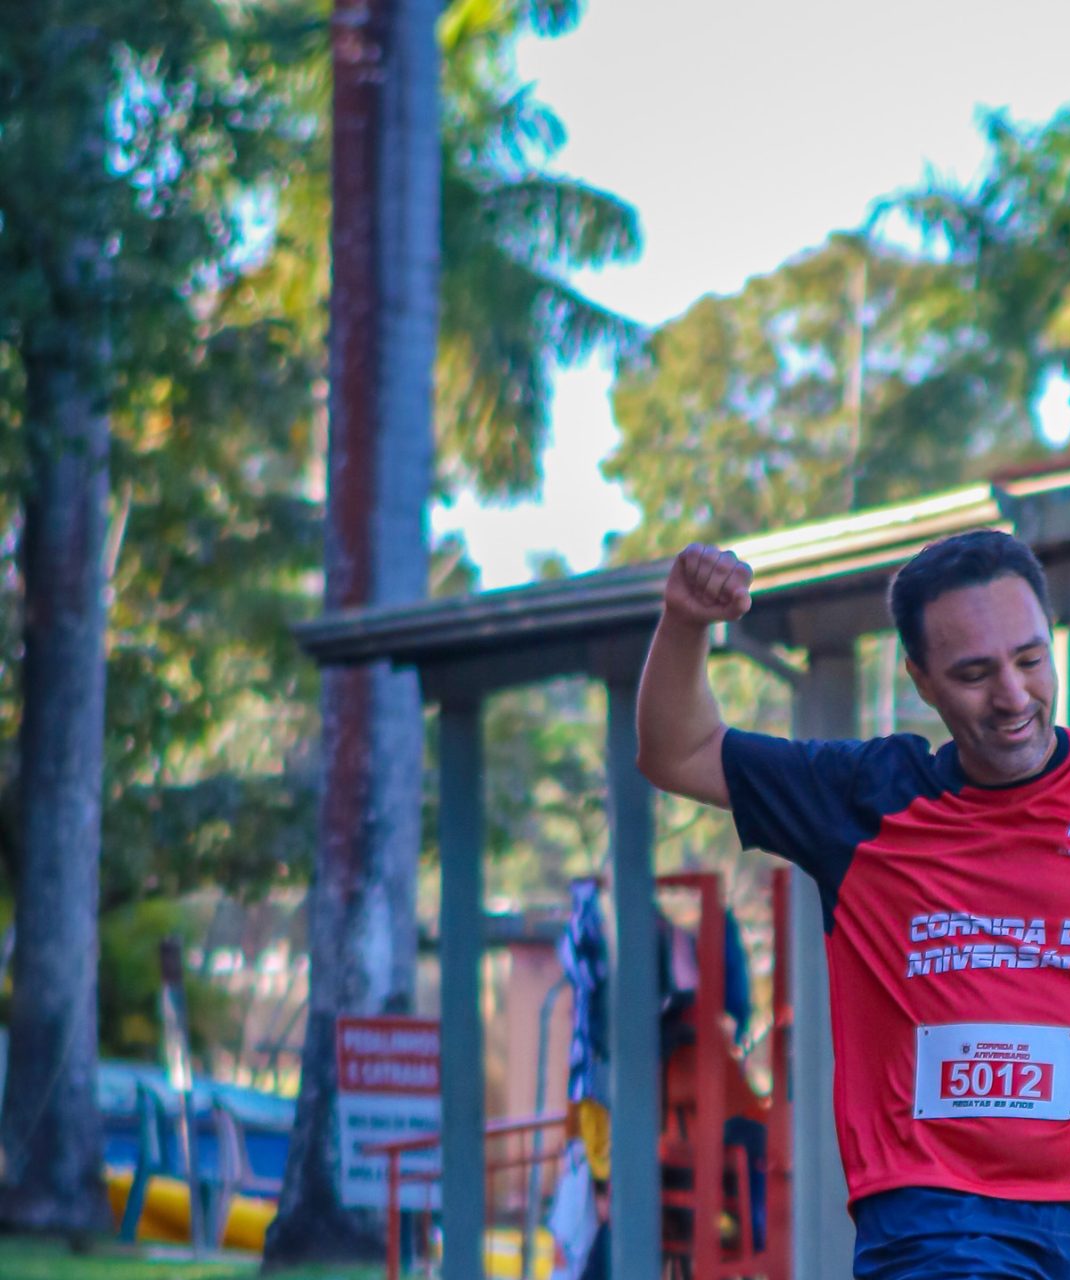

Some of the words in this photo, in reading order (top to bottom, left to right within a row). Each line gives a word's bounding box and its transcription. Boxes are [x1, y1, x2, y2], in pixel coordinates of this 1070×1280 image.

[911, 912, 1046, 944] CORRIDA
[949, 1063, 1042, 1098] 5012
[952, 1100, 991, 1108] REGATAS
[1009, 1101, 1034, 1109] ANOS
